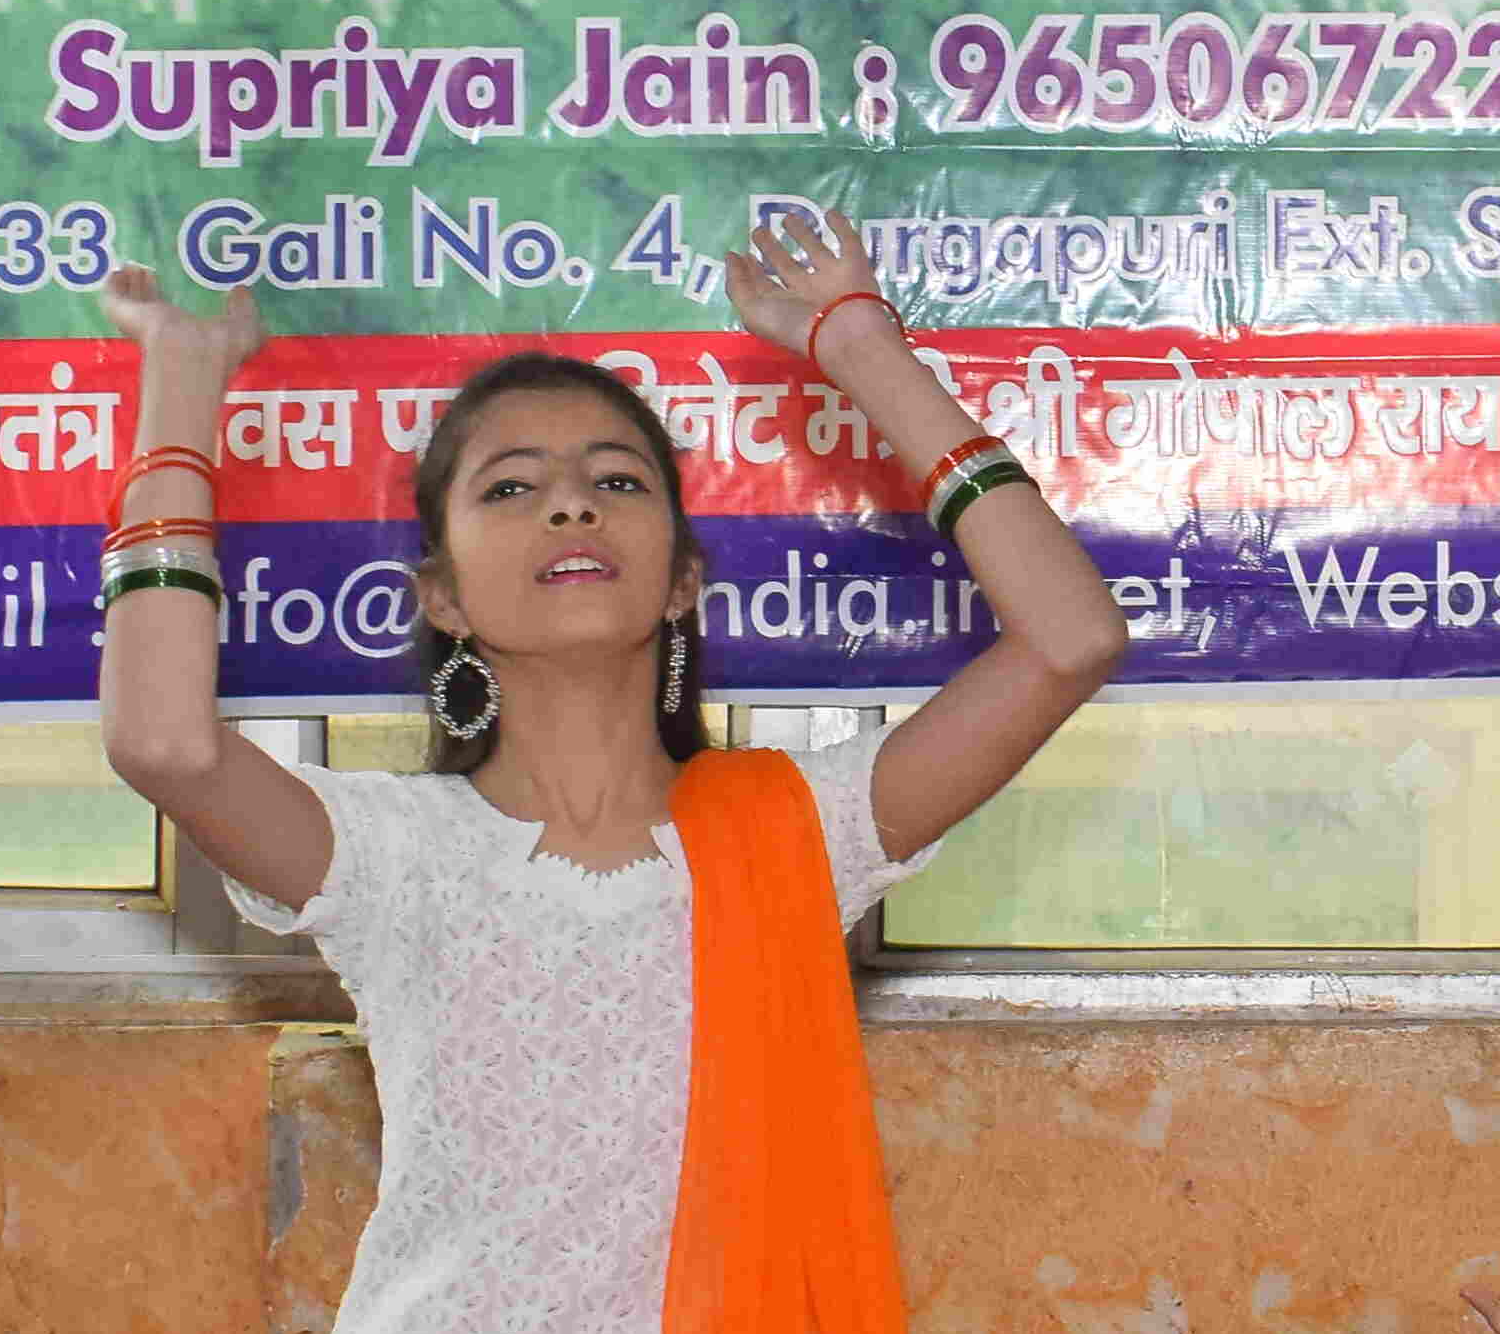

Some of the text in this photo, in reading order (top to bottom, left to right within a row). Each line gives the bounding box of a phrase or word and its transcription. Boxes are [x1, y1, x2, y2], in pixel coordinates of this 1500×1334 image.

[54, 19, 522, 165] Supriya
[554, 19, 814, 133] Jain
[184, 197, 378, 287] Gali
[420, 197, 586, 287] No.
[616, 197, 722, 299] 4,
[1272, 191, 1430, 279] Ext.
[1102, 347, 1362, 459] गोपाल
